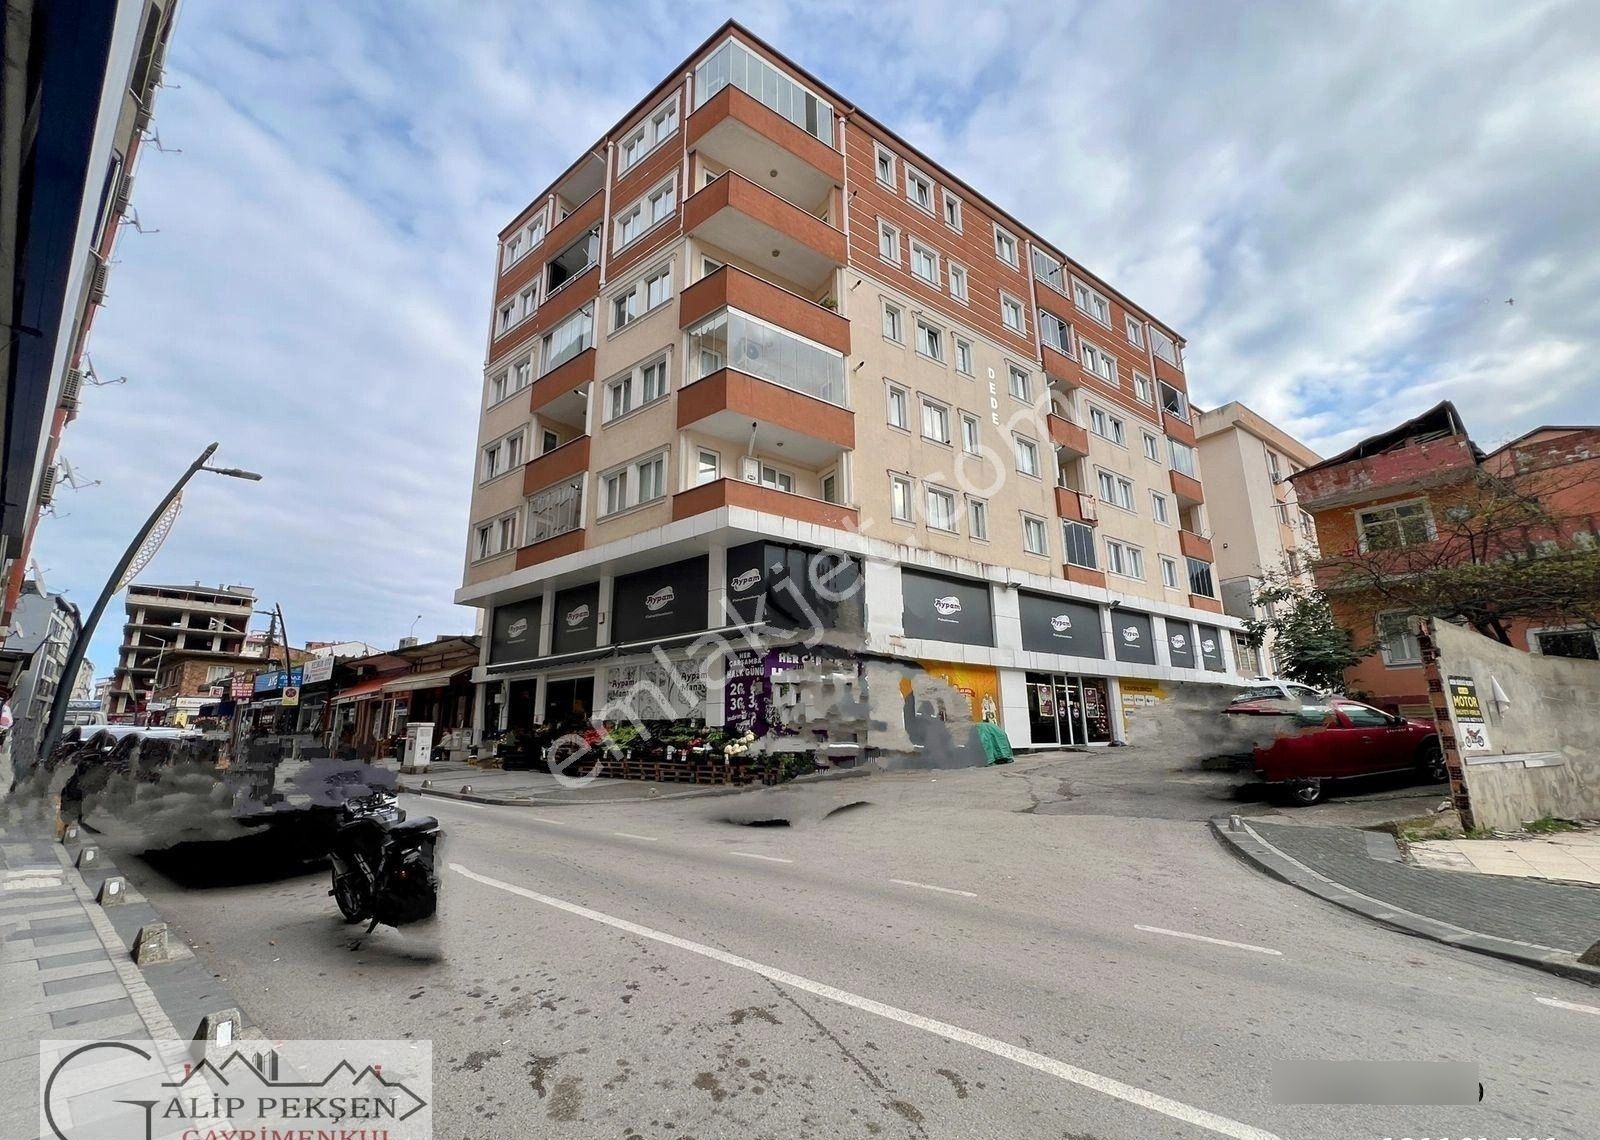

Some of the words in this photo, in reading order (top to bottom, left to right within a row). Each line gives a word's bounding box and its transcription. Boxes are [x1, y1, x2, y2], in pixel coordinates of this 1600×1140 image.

[988, 367, 1000, 426] DEDE
[732, 575, 760, 586] Aypam
[647, 594, 674, 605] Aypam
[745, 665, 765, 676] GÜNÜ
[1452, 695, 1479, 707] MOTOR
